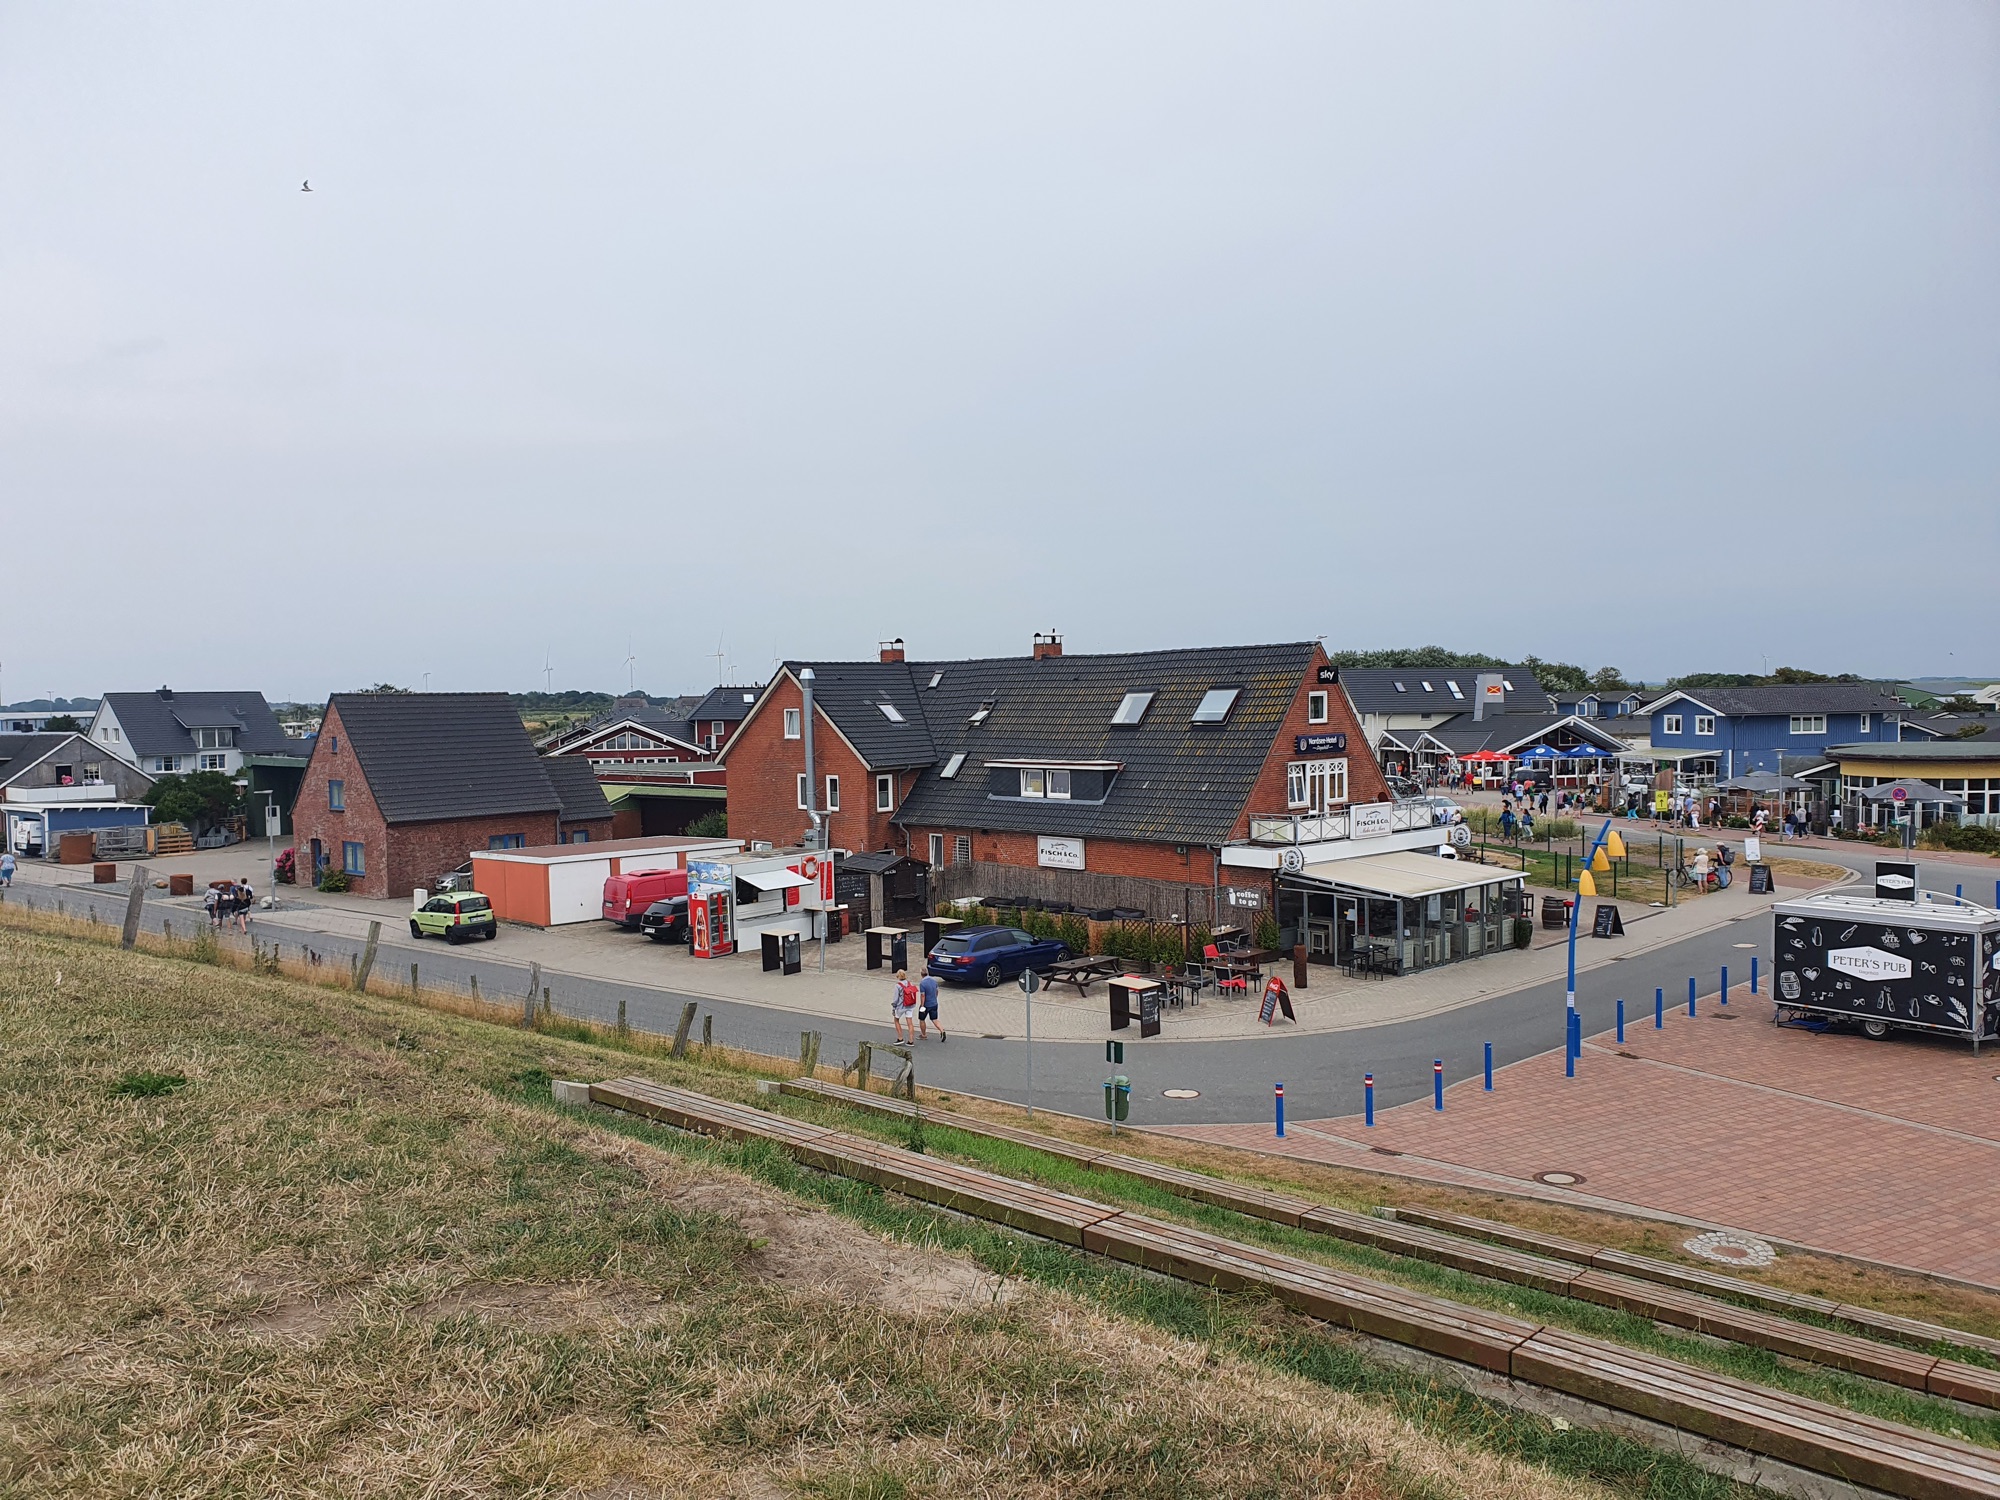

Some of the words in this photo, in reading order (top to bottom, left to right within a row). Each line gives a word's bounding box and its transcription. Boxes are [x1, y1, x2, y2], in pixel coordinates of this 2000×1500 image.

[1320, 670, 1334, 680] sky
[1236, 891, 1259, 899] coffee
[1833, 955, 1880, 969] PETER'S
[1883, 961, 1907, 973] PUB
